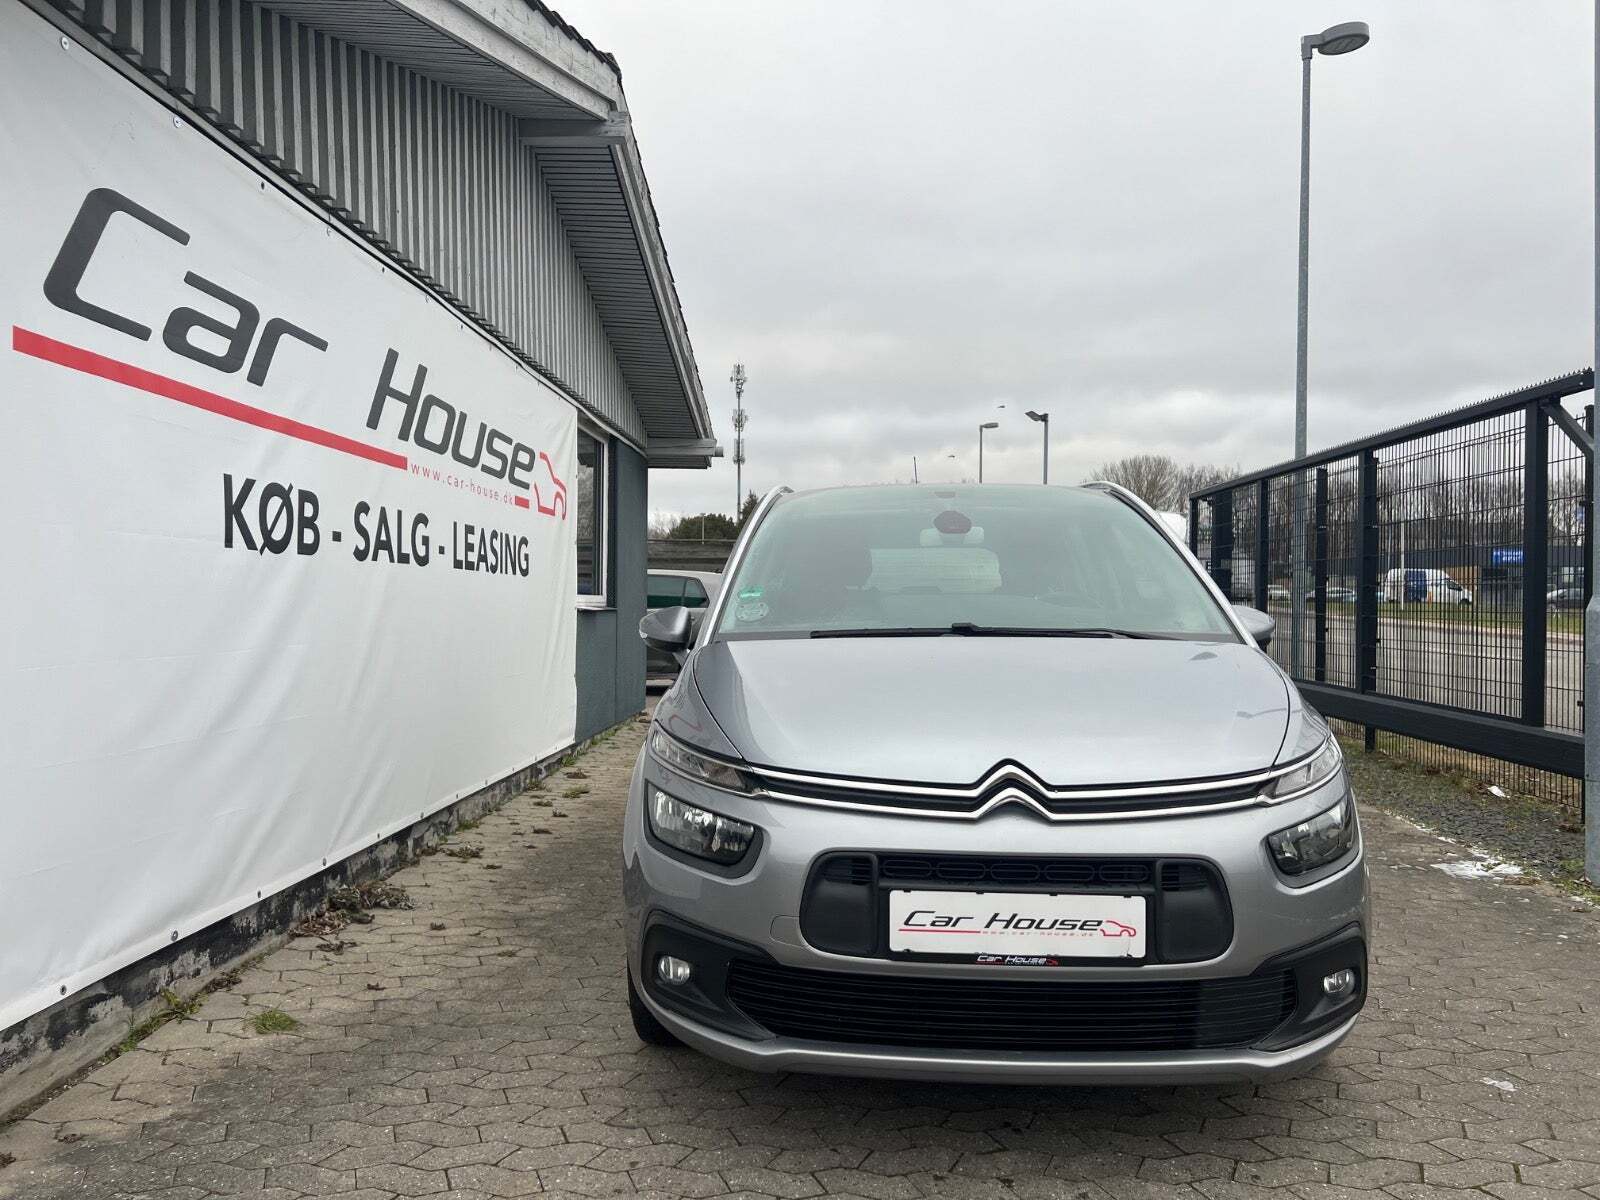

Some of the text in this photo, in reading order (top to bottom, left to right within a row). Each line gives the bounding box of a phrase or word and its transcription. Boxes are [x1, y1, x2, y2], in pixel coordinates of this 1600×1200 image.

[43, 187, 536, 490] Car House
[411, 463, 514, 505] www.car-house.dk
[223, 472, 320, 556] KØB
[352, 501, 430, 567] SALG
[452, 521, 530, 578] LEASING
[903, 910, 1103, 931] Car House
[1005, 955, 1047, 964] House
